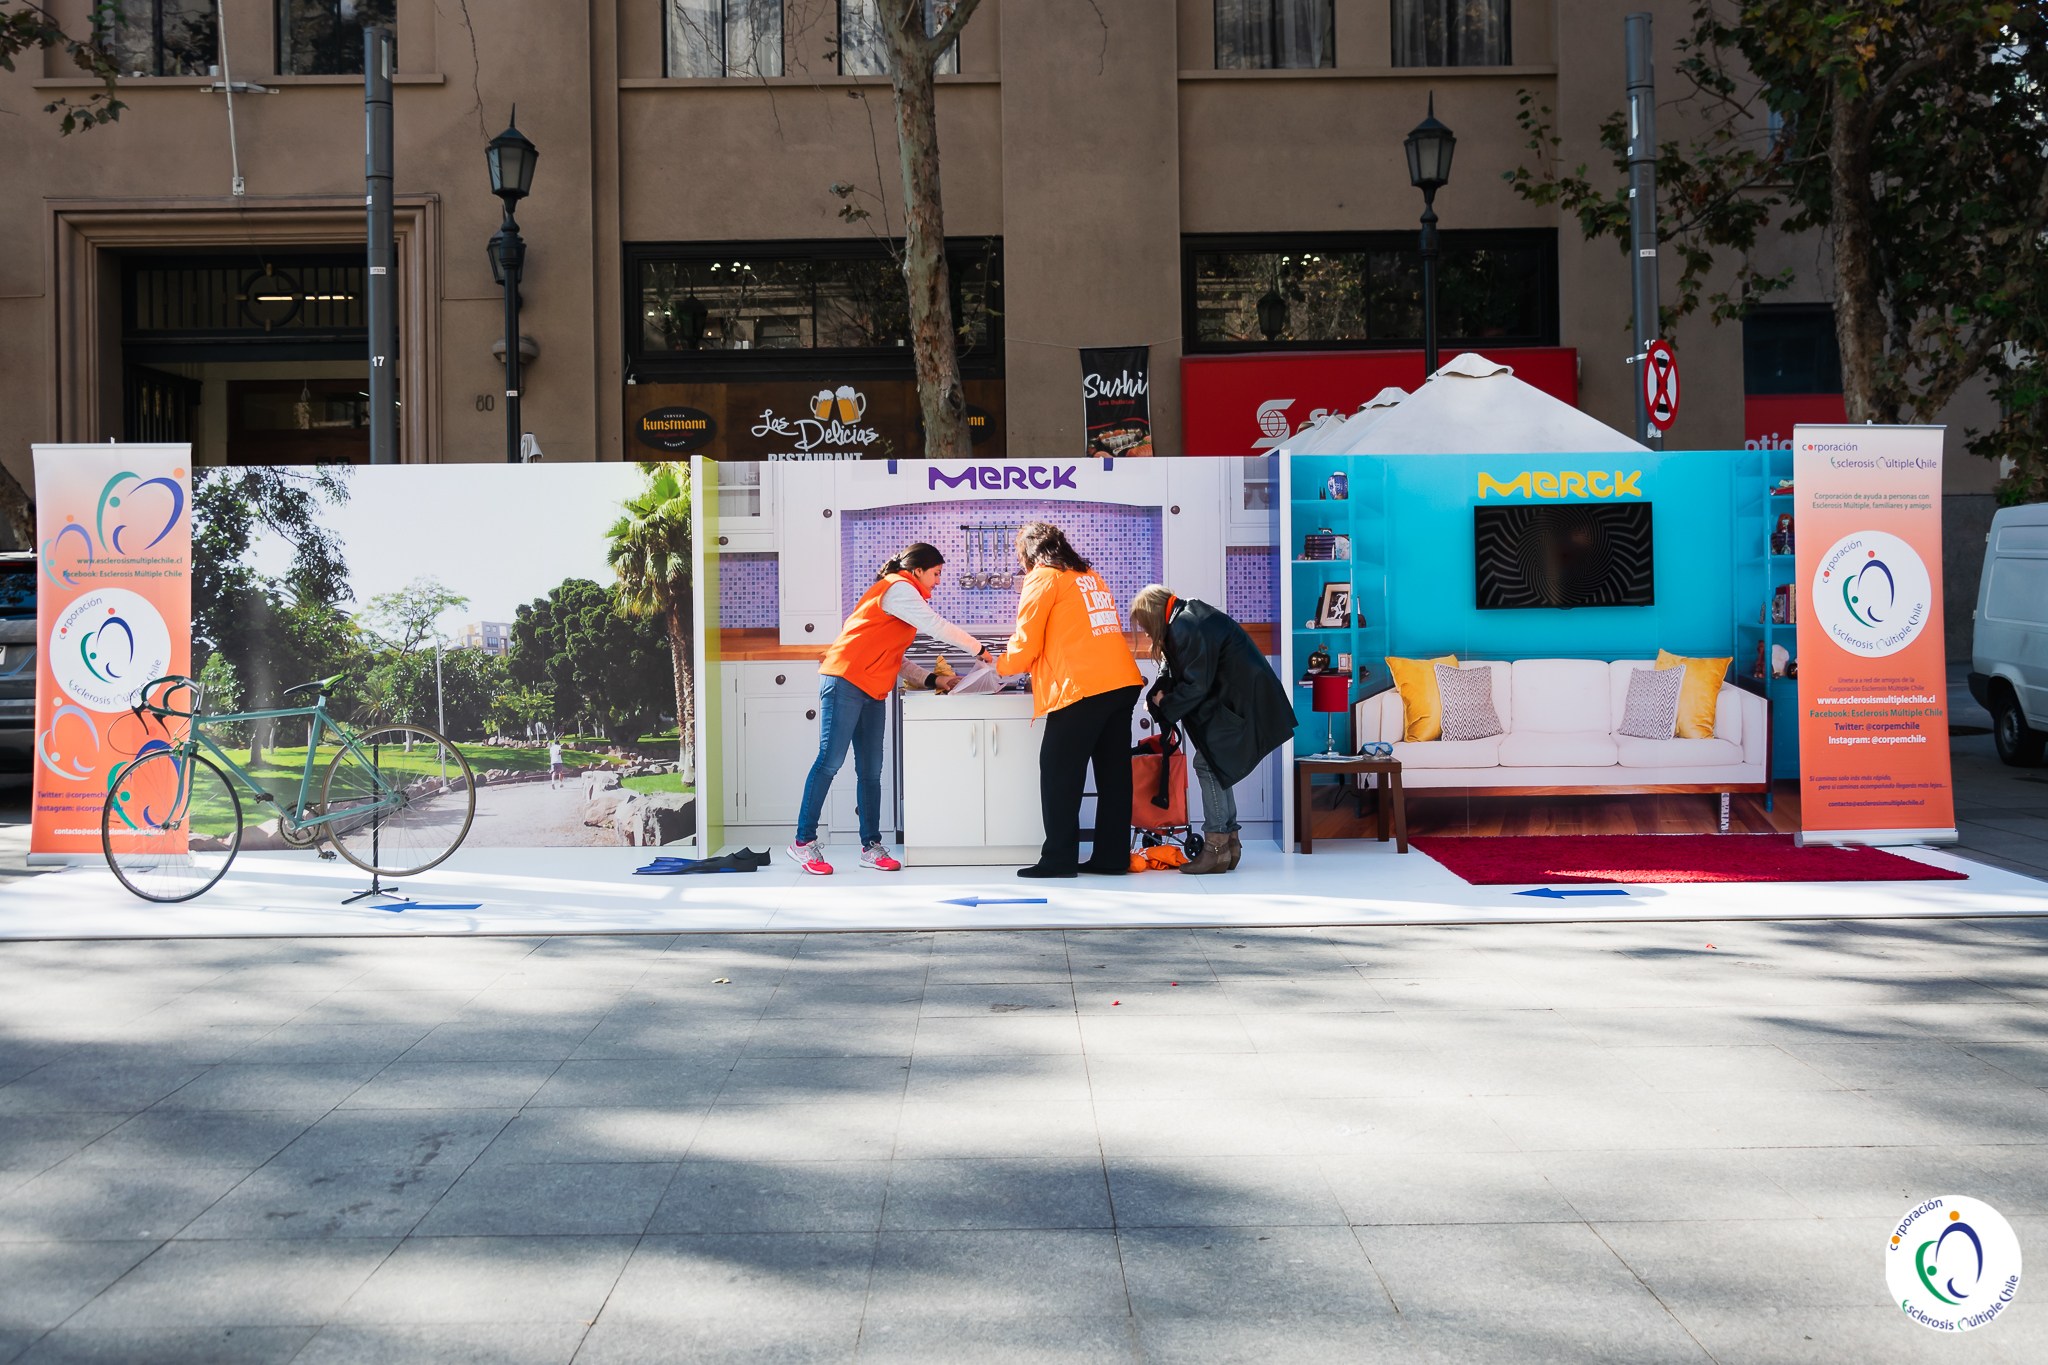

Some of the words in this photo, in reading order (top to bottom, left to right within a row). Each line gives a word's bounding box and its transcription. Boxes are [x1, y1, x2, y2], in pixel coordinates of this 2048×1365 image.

[372, 356, 385, 367] 17
[1083, 370, 1147, 399] Sushi
[643, 417, 707, 430] kunstmann
[751, 409, 799, 437] Las
[794, 419, 879, 452] Delicias
[1802, 442, 1858, 453] corporación
[1830, 456, 1875, 469] Esclerosis
[1876, 456, 1914, 470] Múltiple
[1915, 457, 1937, 469] Chile
[1863, 493, 1882, 501] ayuda
[1909, 502, 1931, 510] amigos
[77, 557, 182, 565] www.esclerosismultiplechile.cl
[1076, 575, 1098, 593] SOY
[1082, 591, 1116, 612] LIBRE
[59, 596, 103, 640] corporación
[1832, 624, 1873, 650] Esclerosis
[1908, 602, 1923, 626] Chile
[68, 679, 111, 705] Esclerosis
[1817, 695, 1936, 705] www.esclerosismultiplechile.cl
[1851, 709, 1888, 717] Esclerosis
[1924, 708, 1943, 717] Chile
[1834, 723, 1864, 731] Twitter:
[1866, 722, 1920, 731] @corpemchile
[1828, 736, 1871, 746] Instagram:
[1871, 735, 1926, 745] @corpemchile
[37, 791, 64, 799] Twitter:
[37, 805, 74, 815] Instagram:
